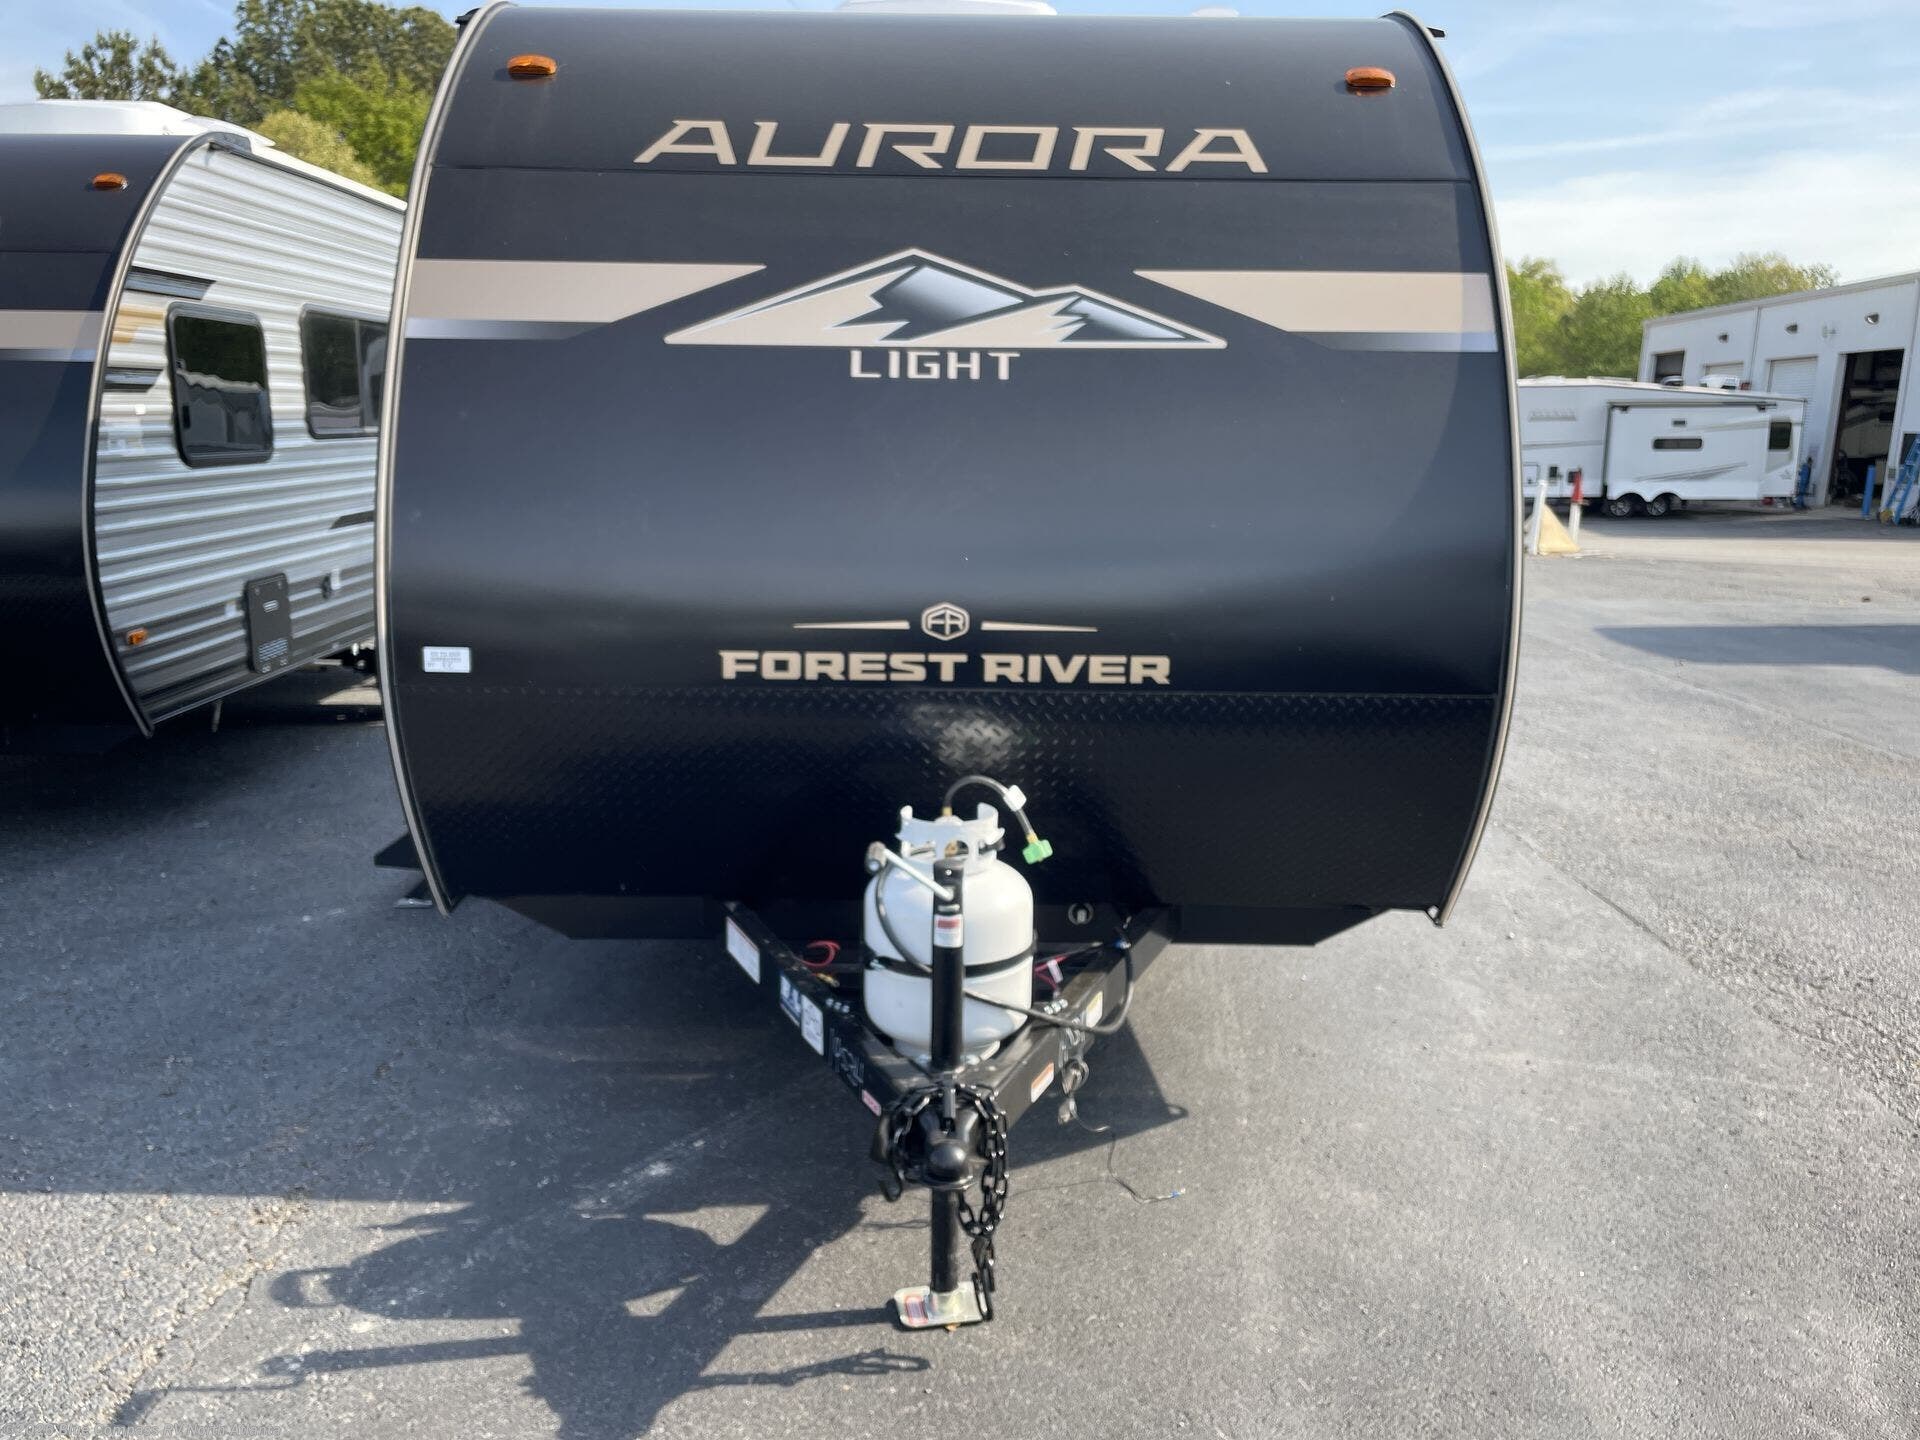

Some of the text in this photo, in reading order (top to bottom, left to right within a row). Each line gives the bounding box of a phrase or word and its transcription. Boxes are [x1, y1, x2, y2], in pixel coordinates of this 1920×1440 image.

[633, 119, 1269, 173] AURORA
[849, 349, 1021, 381] LIGHT
[718, 649, 1171, 685] FOREST RIVER
